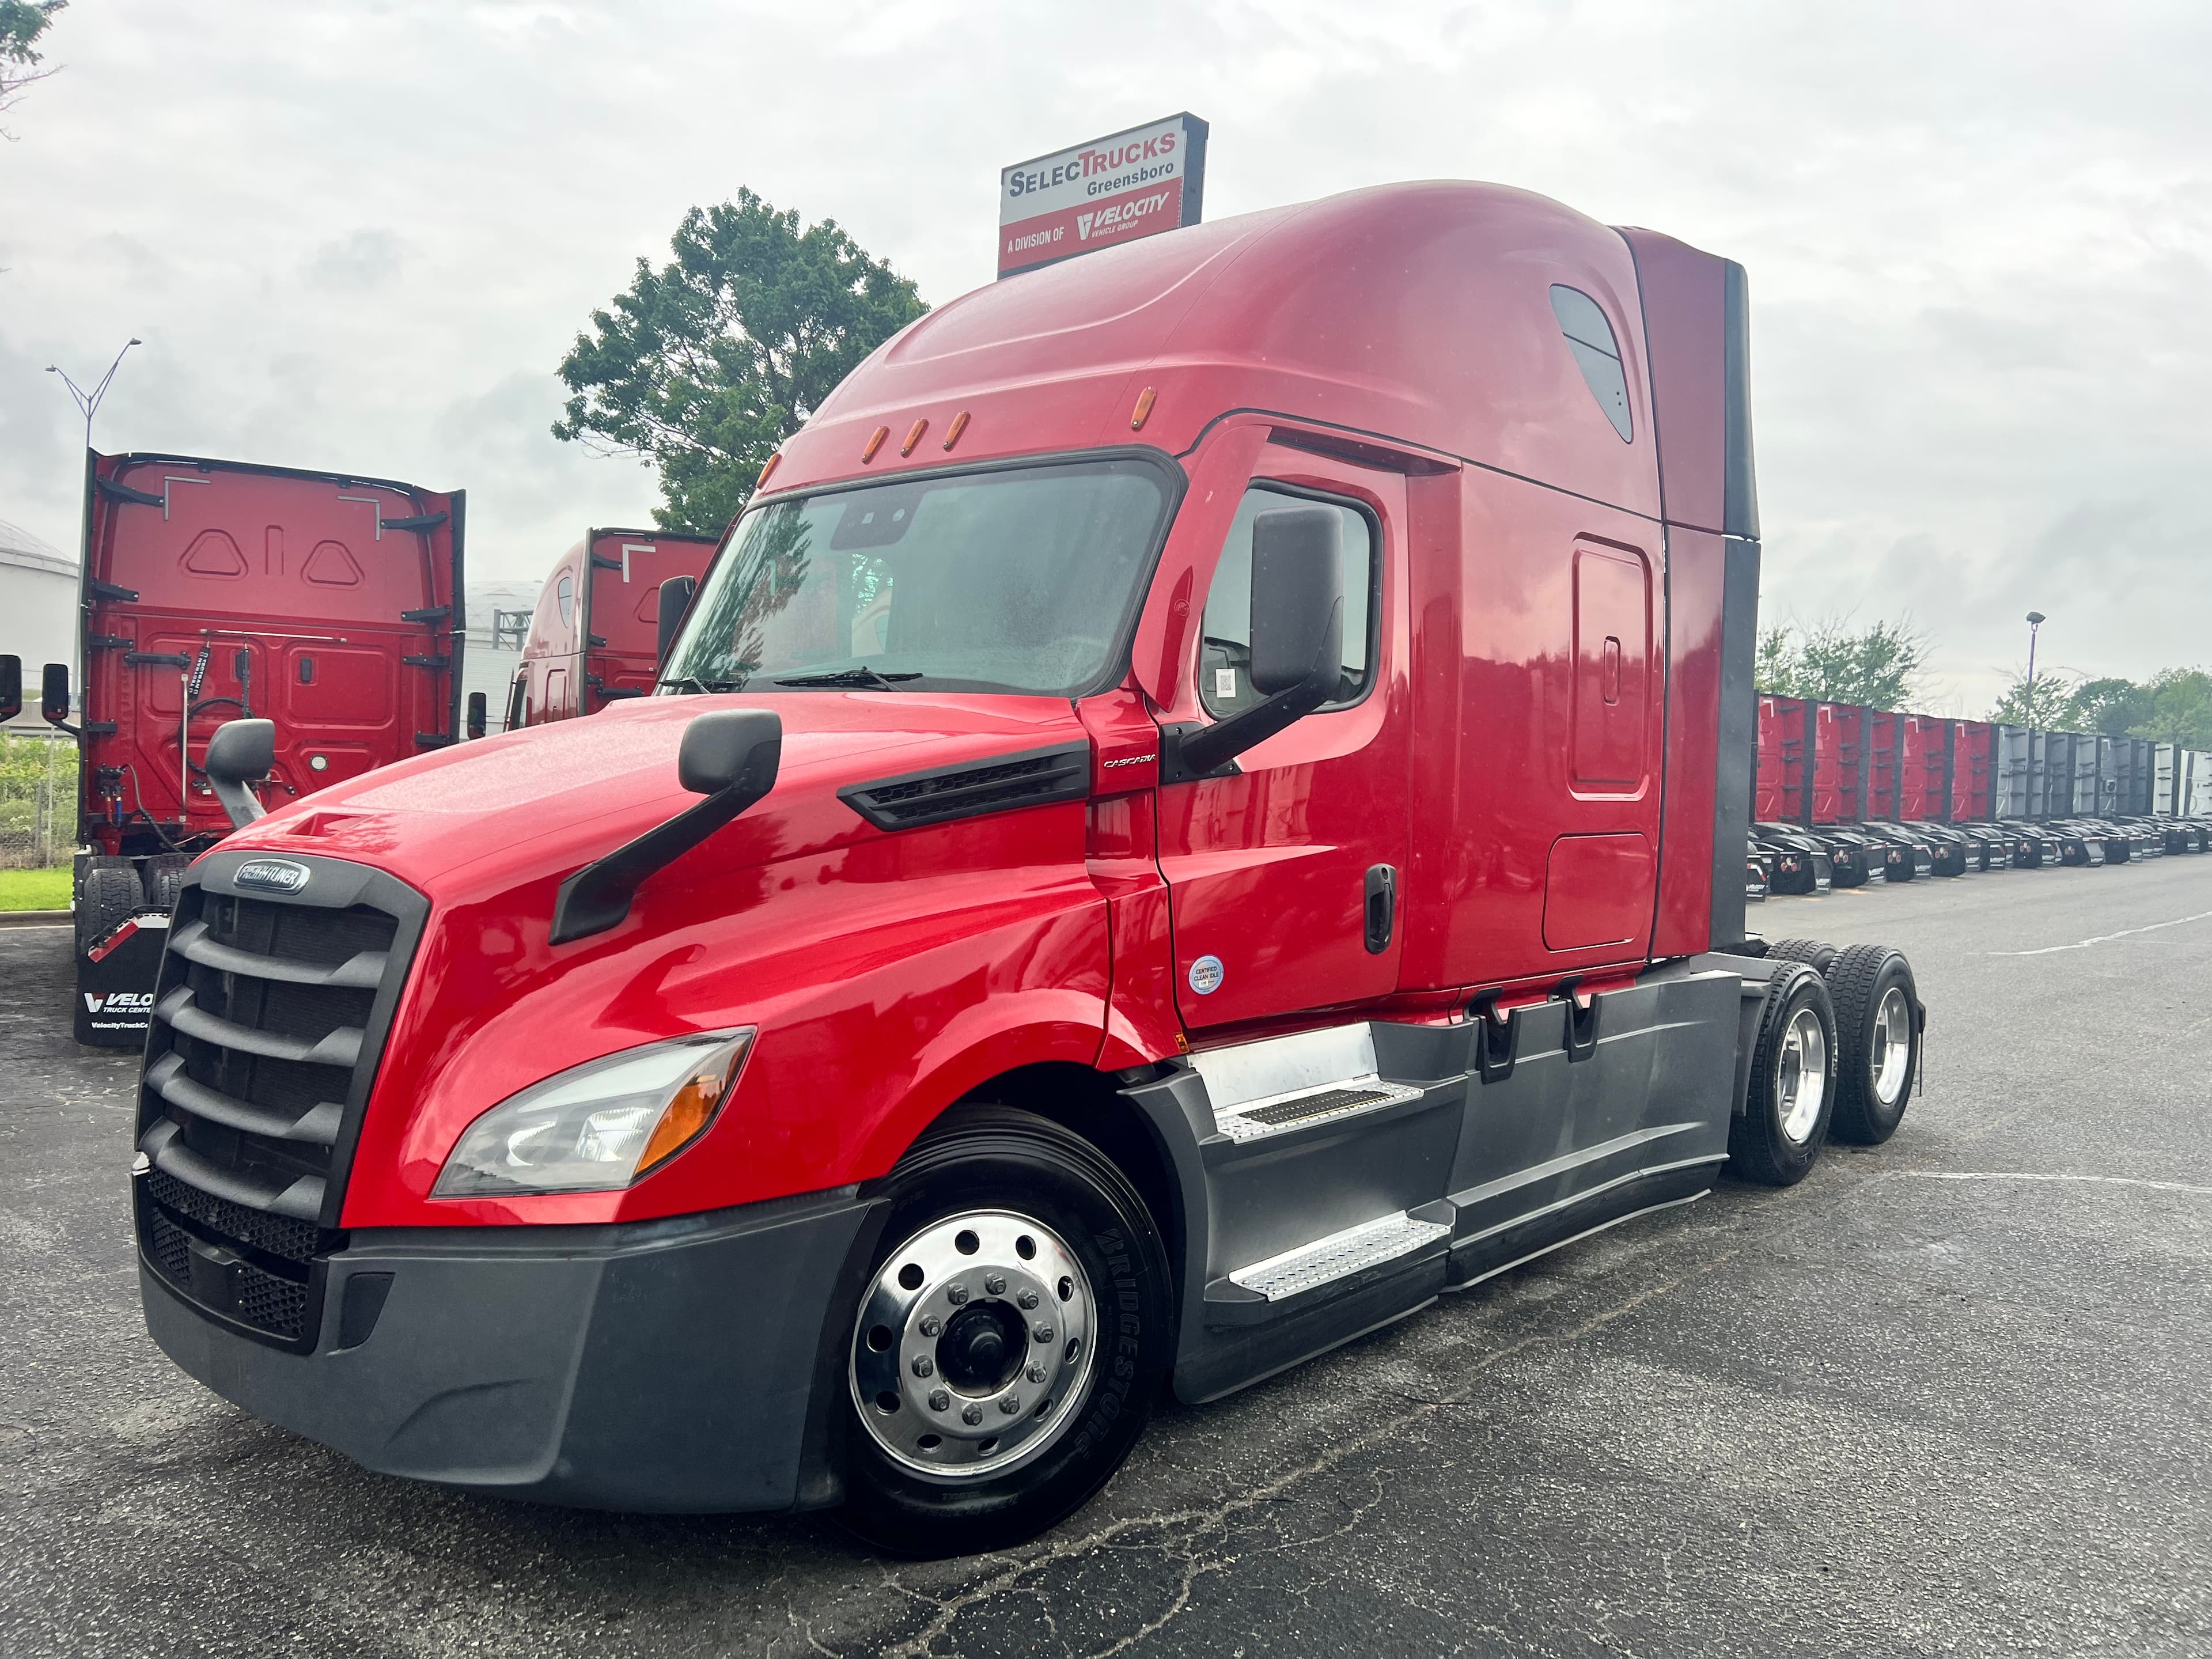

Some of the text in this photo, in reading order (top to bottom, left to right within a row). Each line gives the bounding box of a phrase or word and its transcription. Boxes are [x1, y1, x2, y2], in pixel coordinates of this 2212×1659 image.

[1087, 162, 1174, 196] Greensboro
[1093, 191, 1170, 228] VELOCITY
[1007, 226, 1065, 253] A DIVISION OF
[1092, 219, 1138, 238] VEHICLE GROUP
[1195, 966, 1217, 974] CERTIFIED
